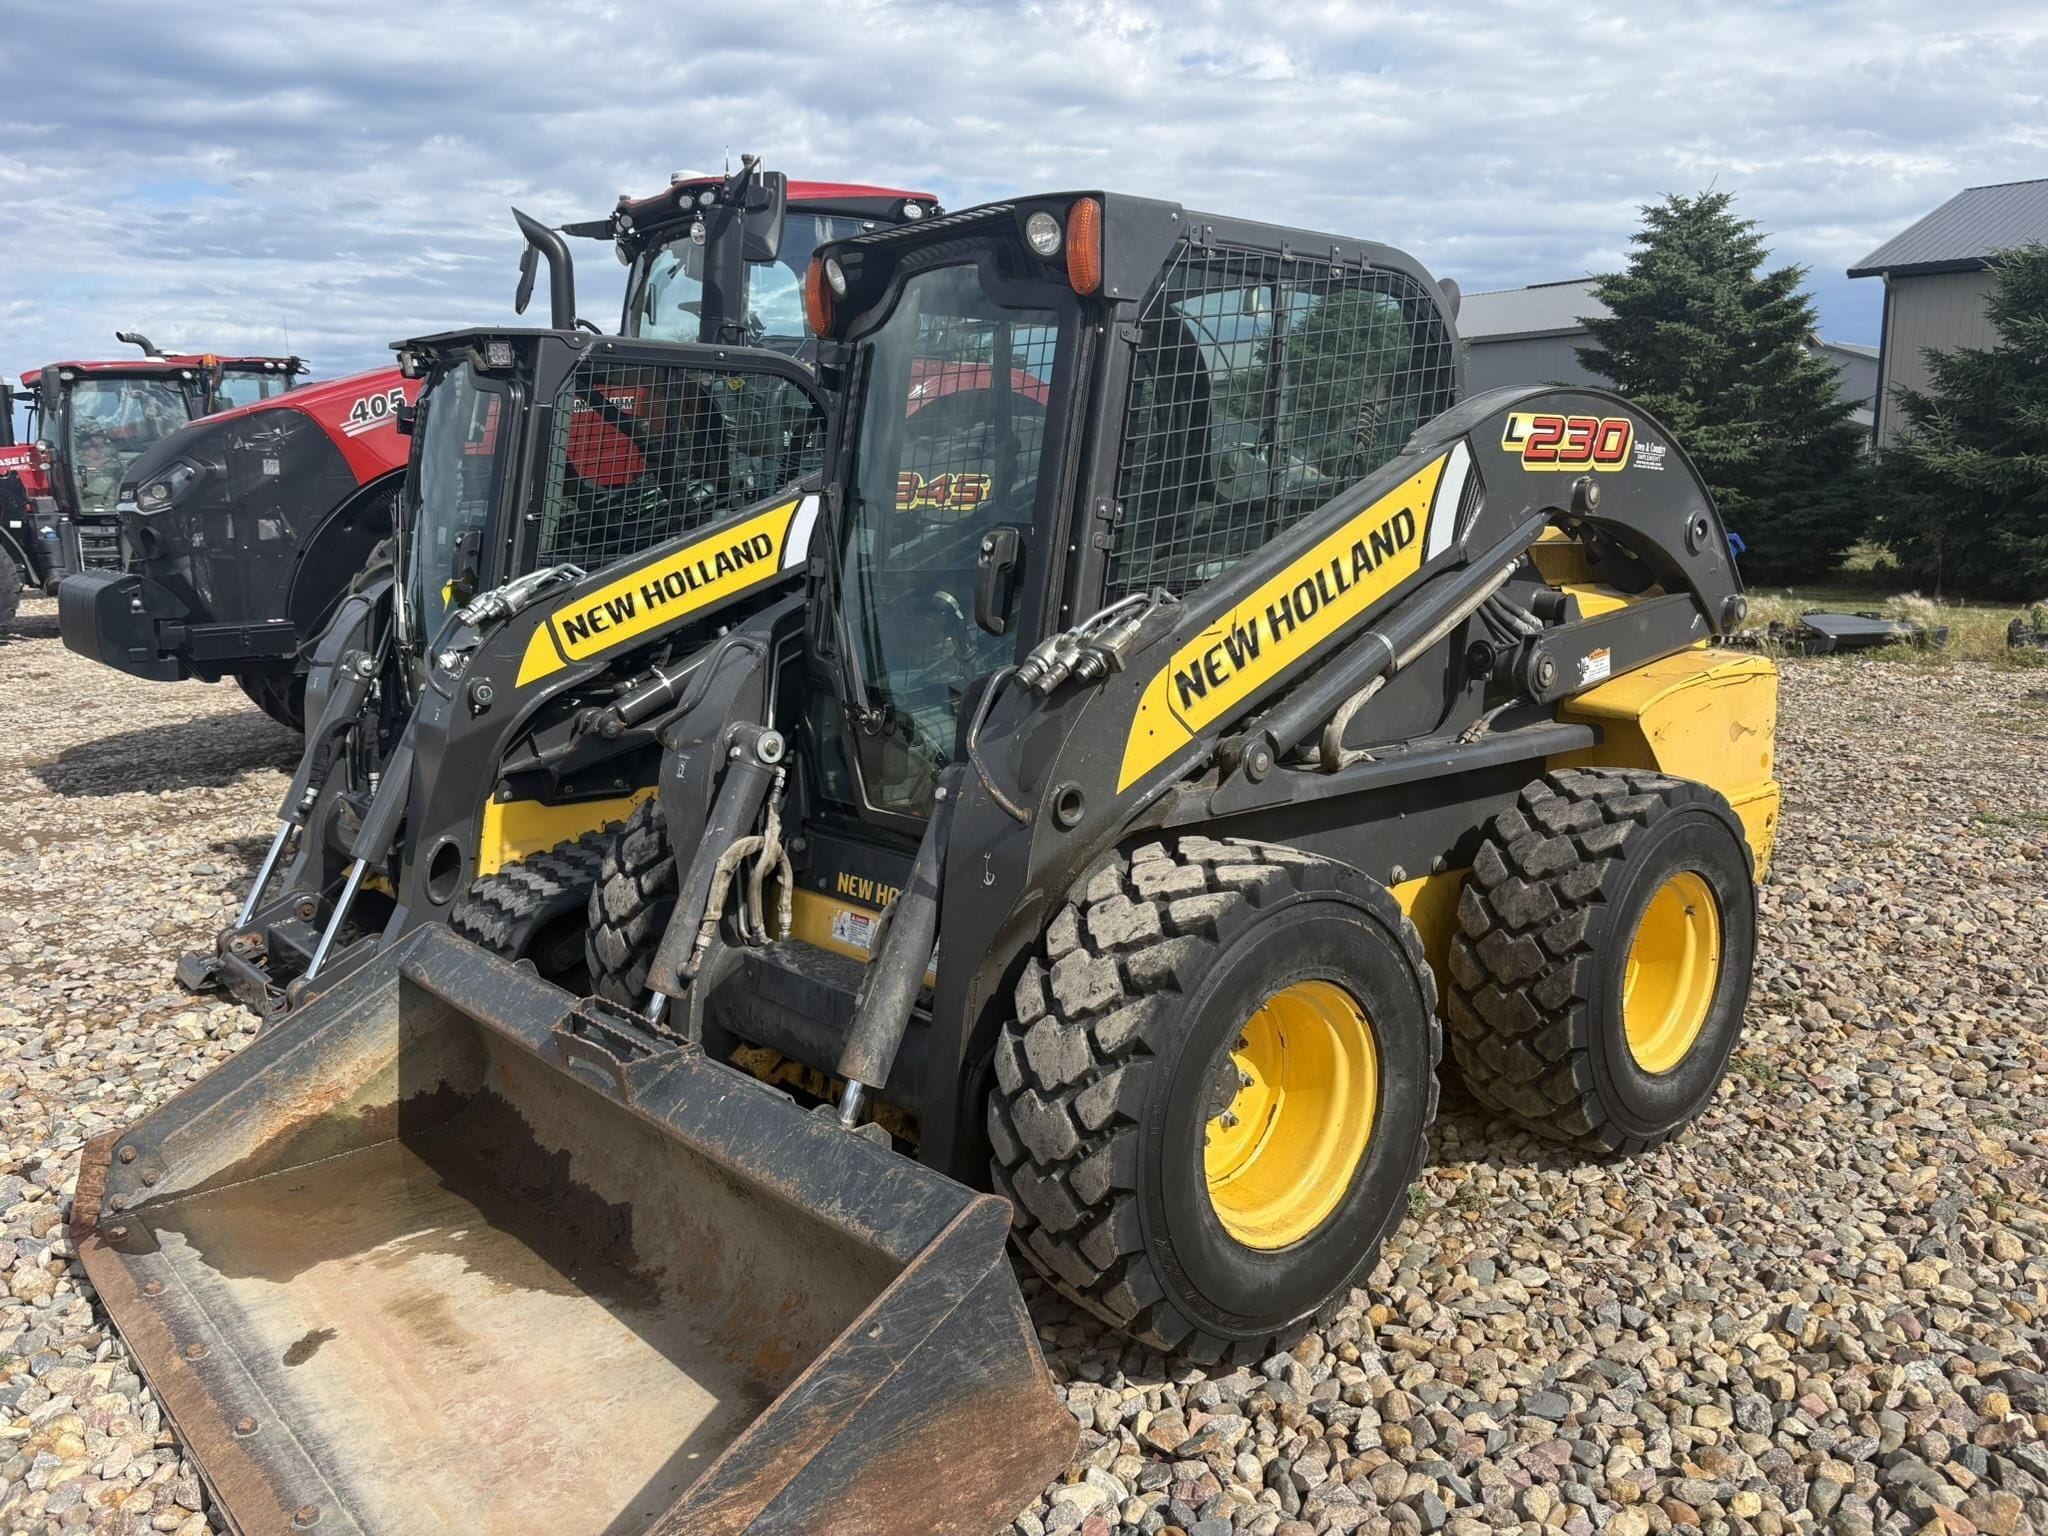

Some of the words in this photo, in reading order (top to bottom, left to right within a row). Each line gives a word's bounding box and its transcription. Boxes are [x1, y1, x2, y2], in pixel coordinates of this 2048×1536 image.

[350, 387, 408, 424] 405
[562, 592, 636, 645] NEW
[640, 533, 773, 610] HOLLAND
[1174, 618, 1260, 711] NEW
[1265, 507, 1416, 644] HOLLAND
[837, 871, 874, 901] NEW
